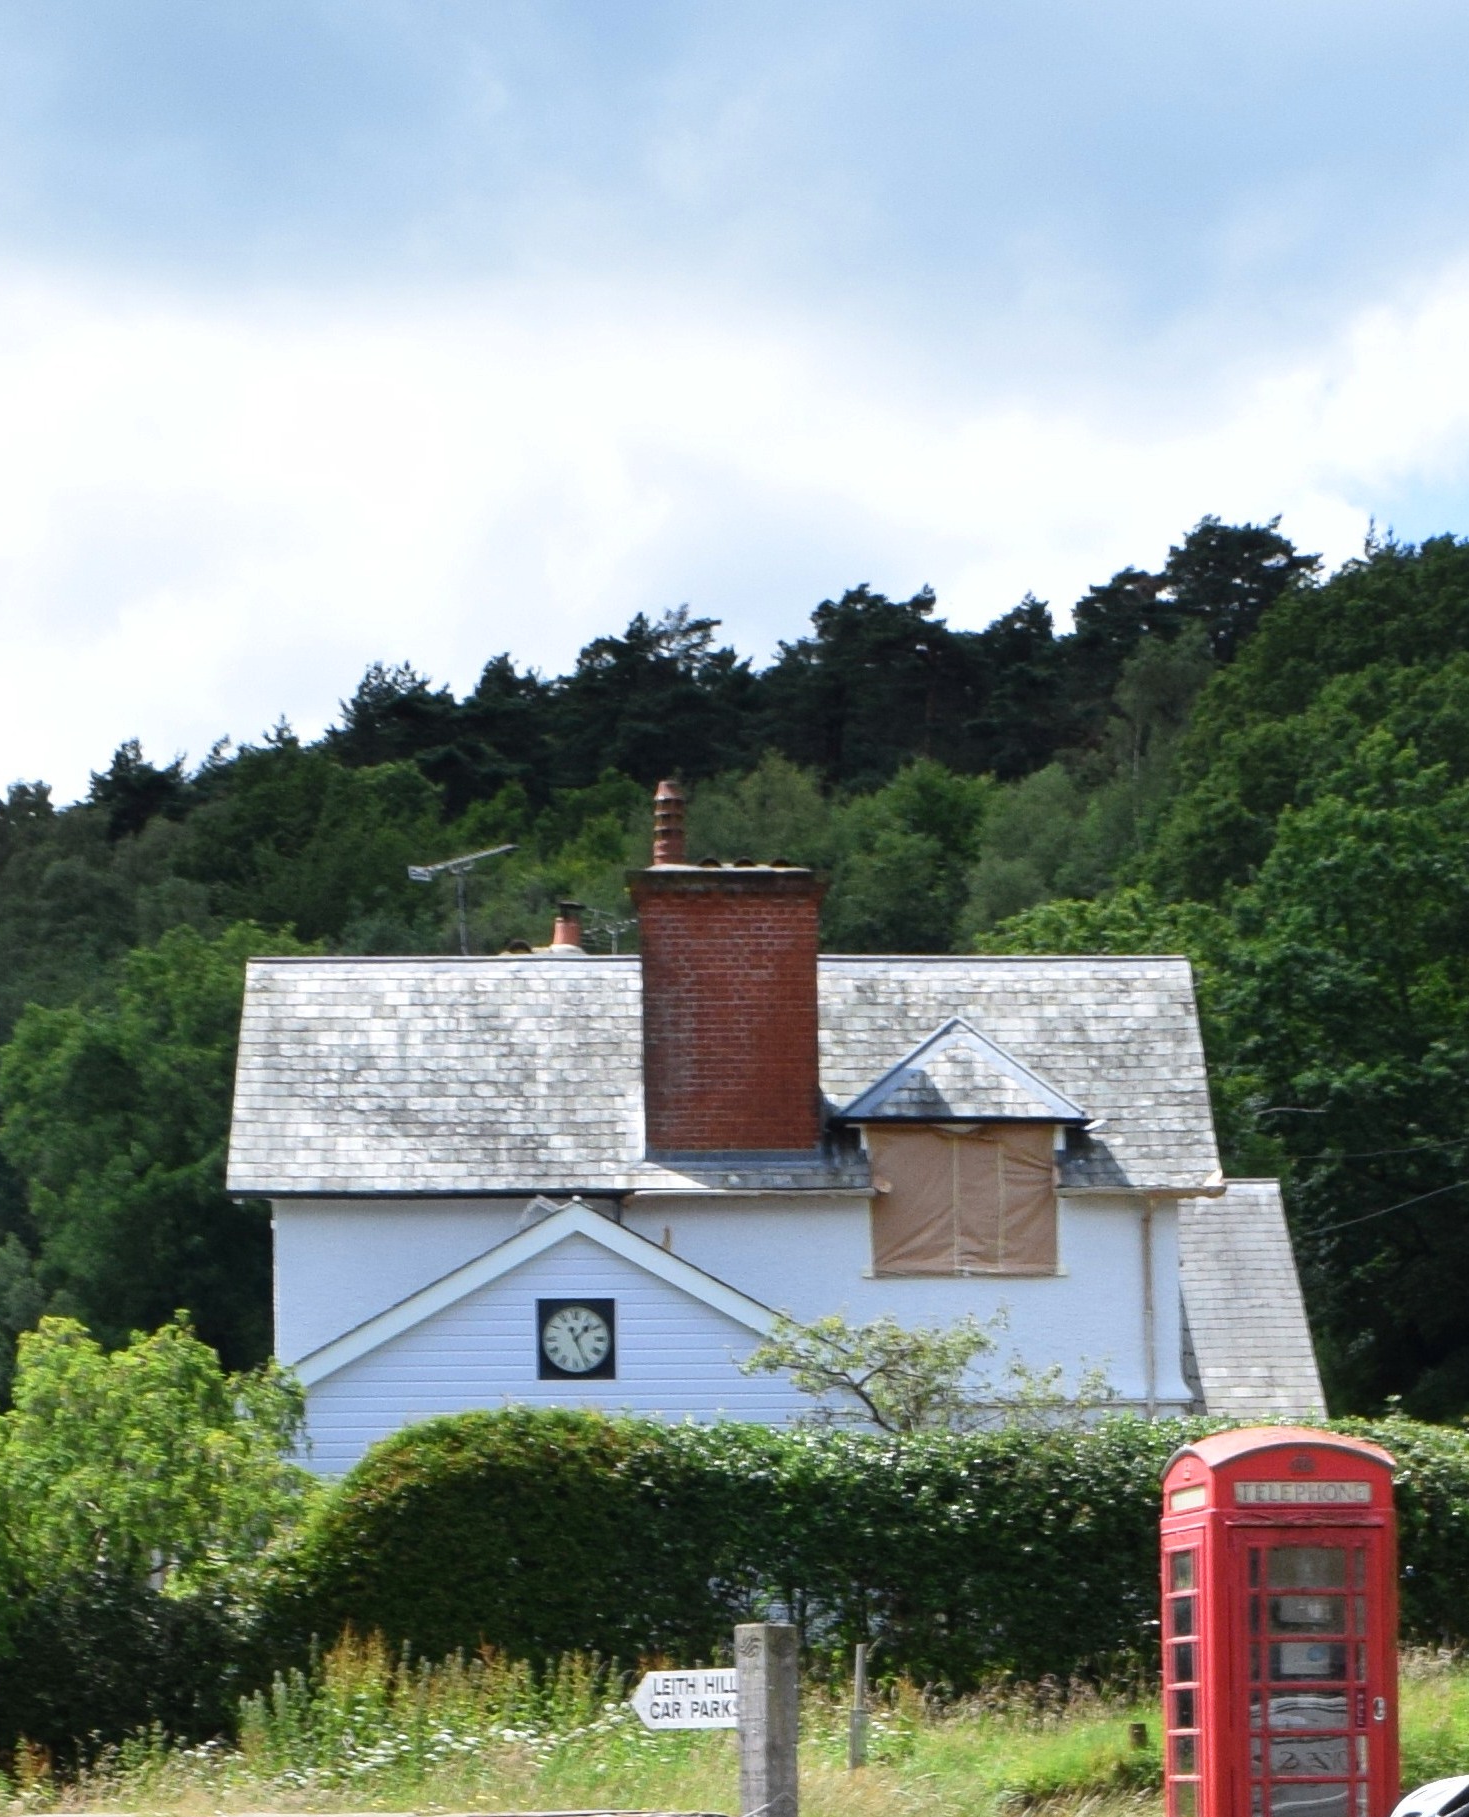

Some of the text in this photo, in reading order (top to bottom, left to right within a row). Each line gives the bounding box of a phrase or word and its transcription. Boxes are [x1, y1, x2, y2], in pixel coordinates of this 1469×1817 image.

[1239, 1483, 1369, 1502] TELEPHONE
[653, 1675, 738, 1696] LEITH HILL
[650, 1701, 683, 1719] CAR
